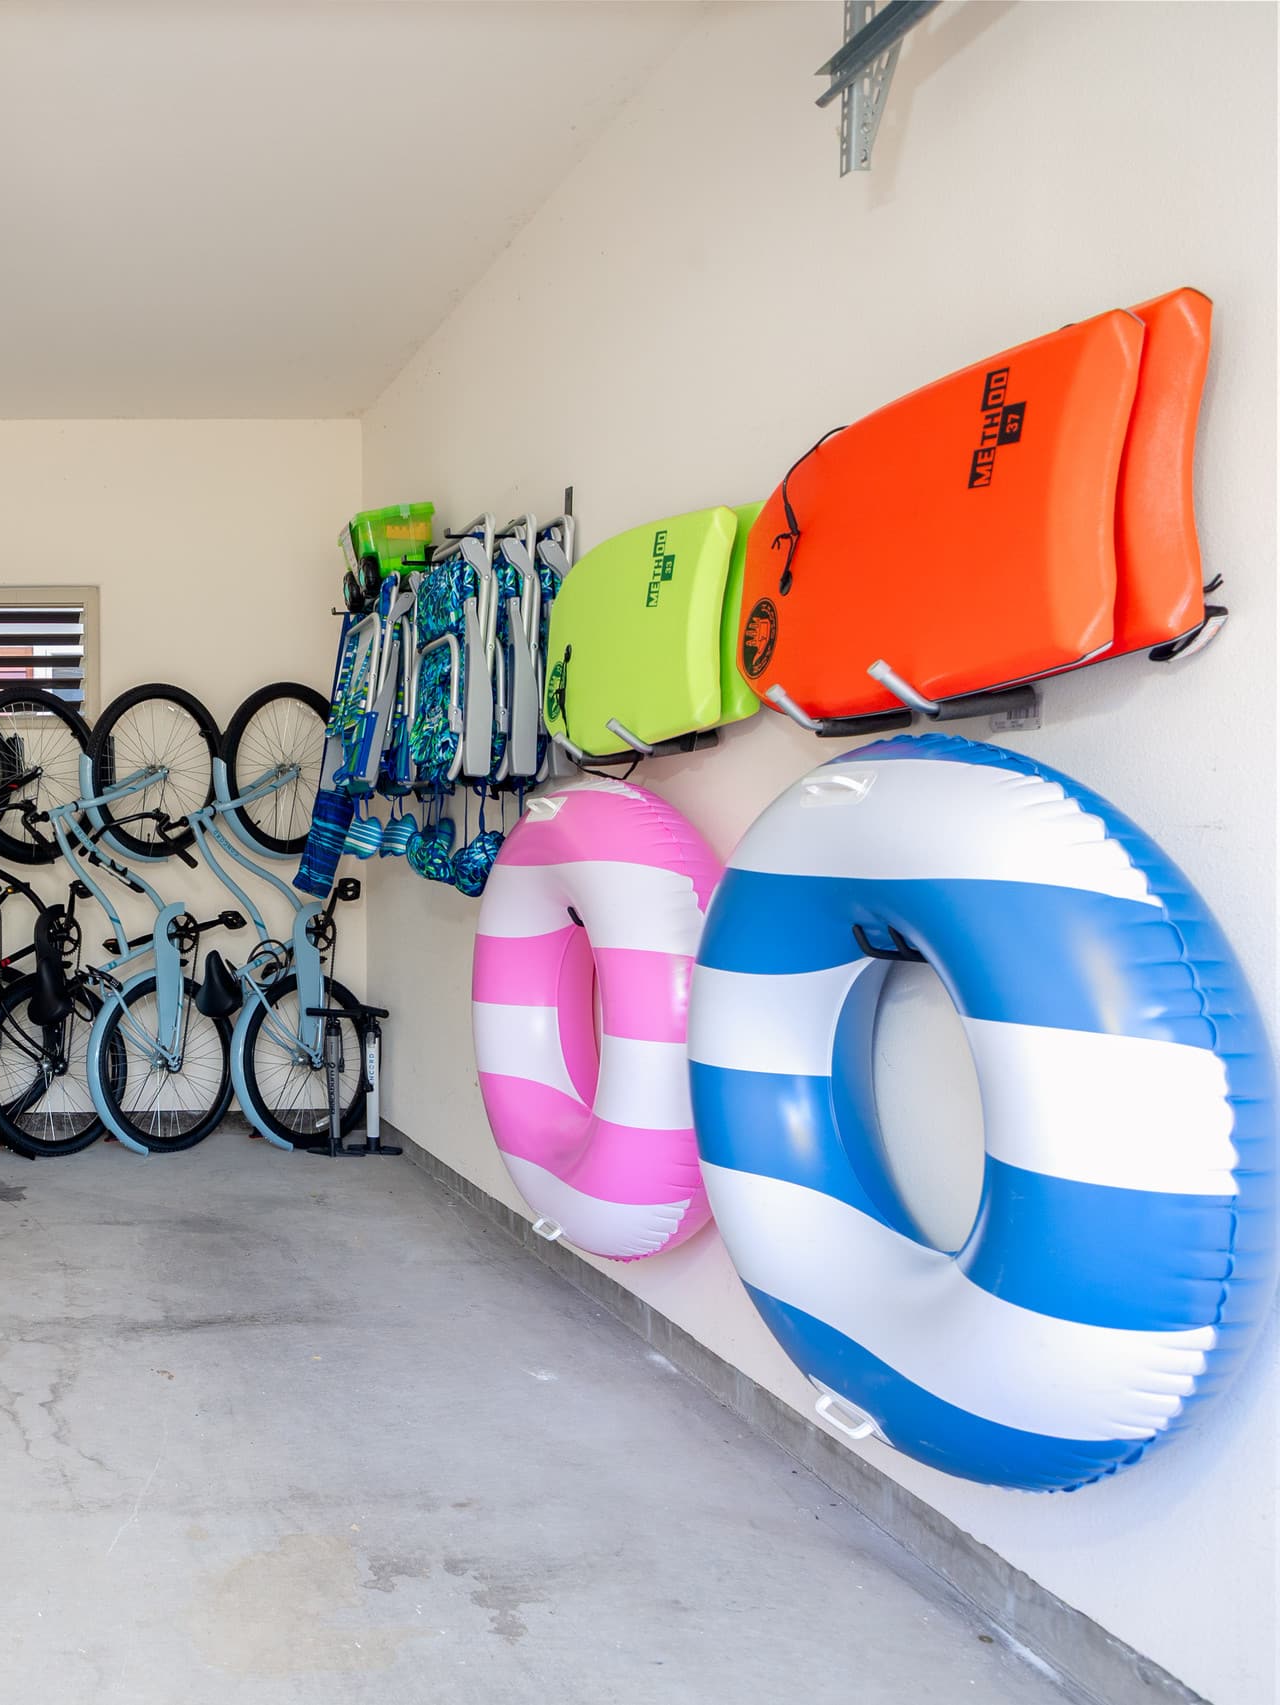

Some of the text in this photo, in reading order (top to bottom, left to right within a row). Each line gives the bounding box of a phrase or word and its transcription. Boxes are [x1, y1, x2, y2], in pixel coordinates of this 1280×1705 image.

[968, 367, 1010, 489] METHOD
[1006, 413, 1020, 434] 37
[646, 530, 668, 608] METHOD
